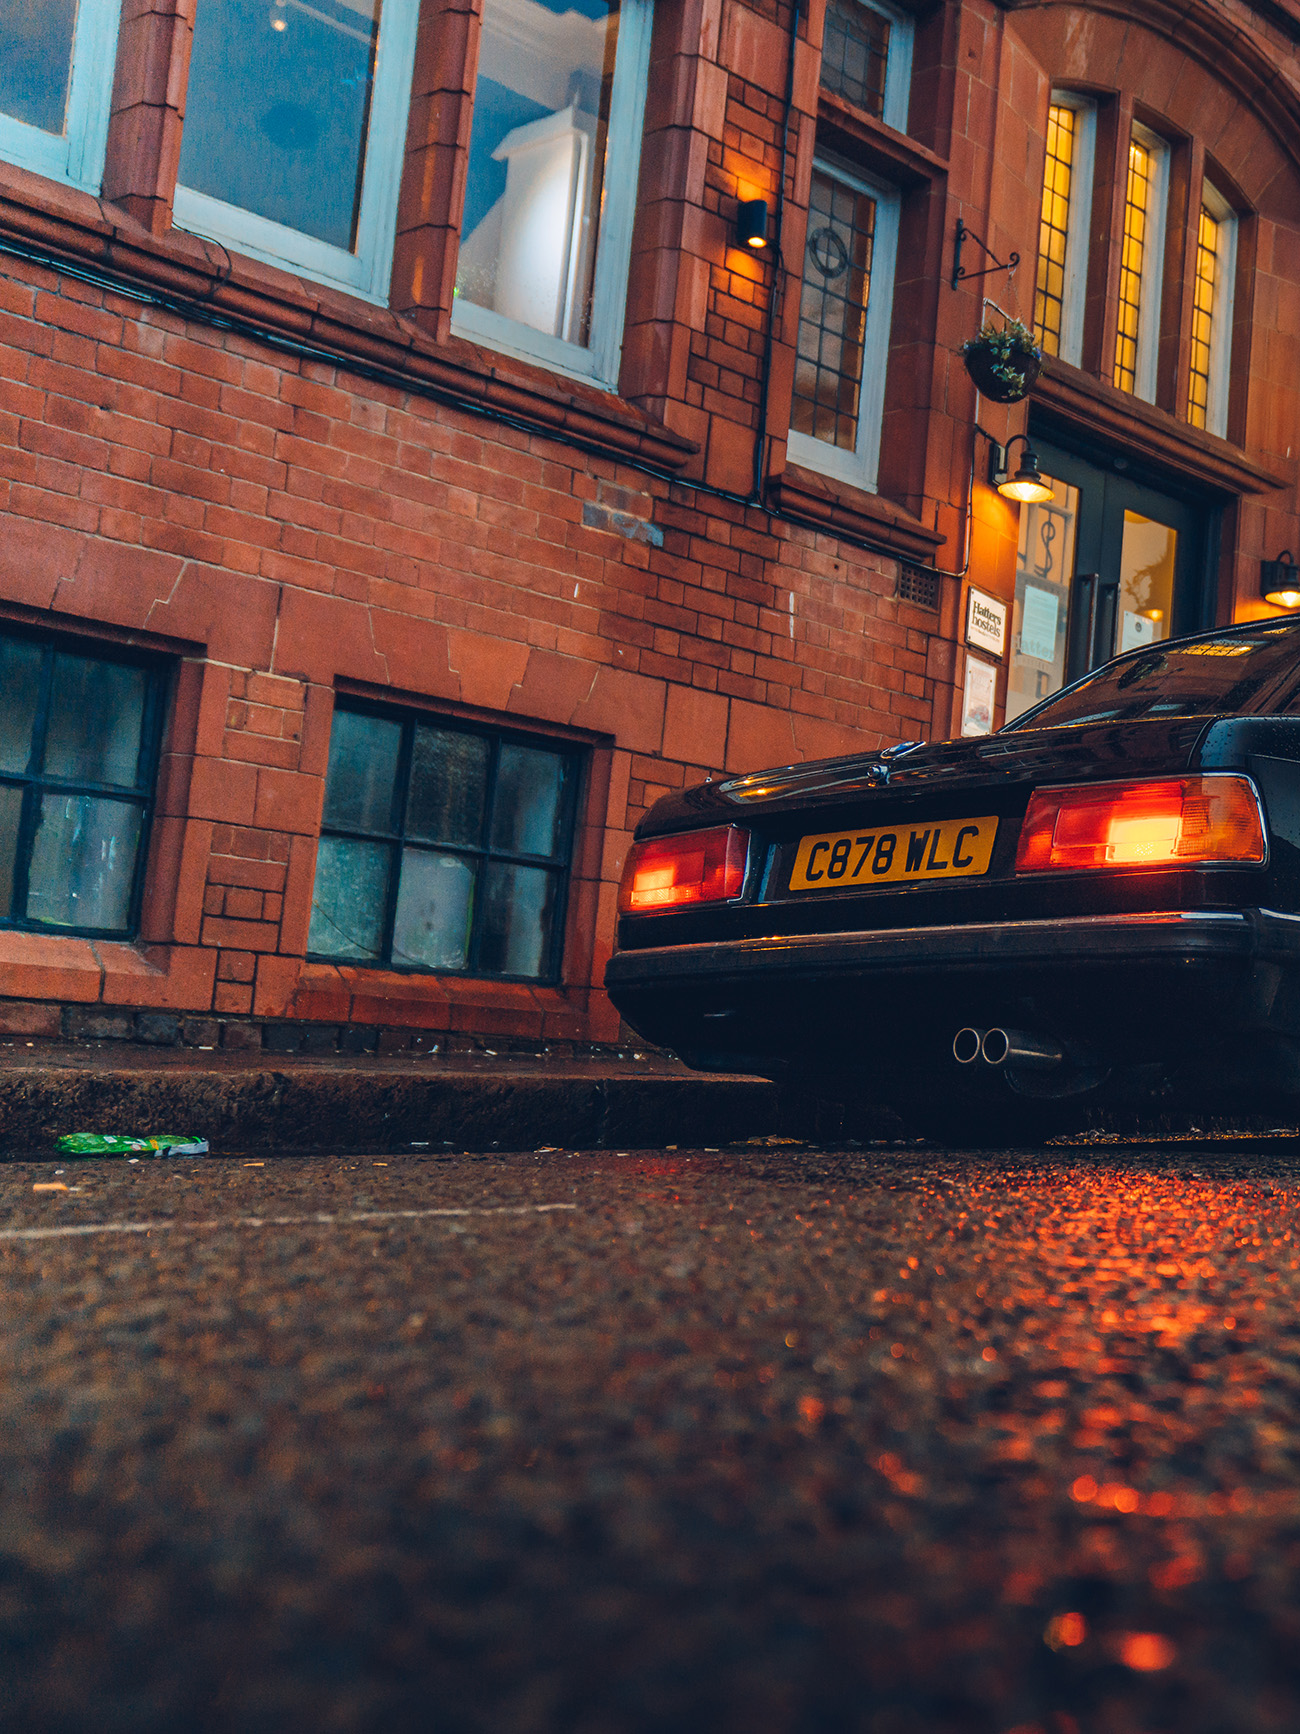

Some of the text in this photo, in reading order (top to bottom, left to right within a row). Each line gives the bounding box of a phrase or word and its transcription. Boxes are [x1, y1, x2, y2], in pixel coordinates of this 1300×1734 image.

[971, 610, 1001, 638] hostels
[972, 600, 1001, 625] Hatters
[806, 825, 979, 881] C878 WLC
